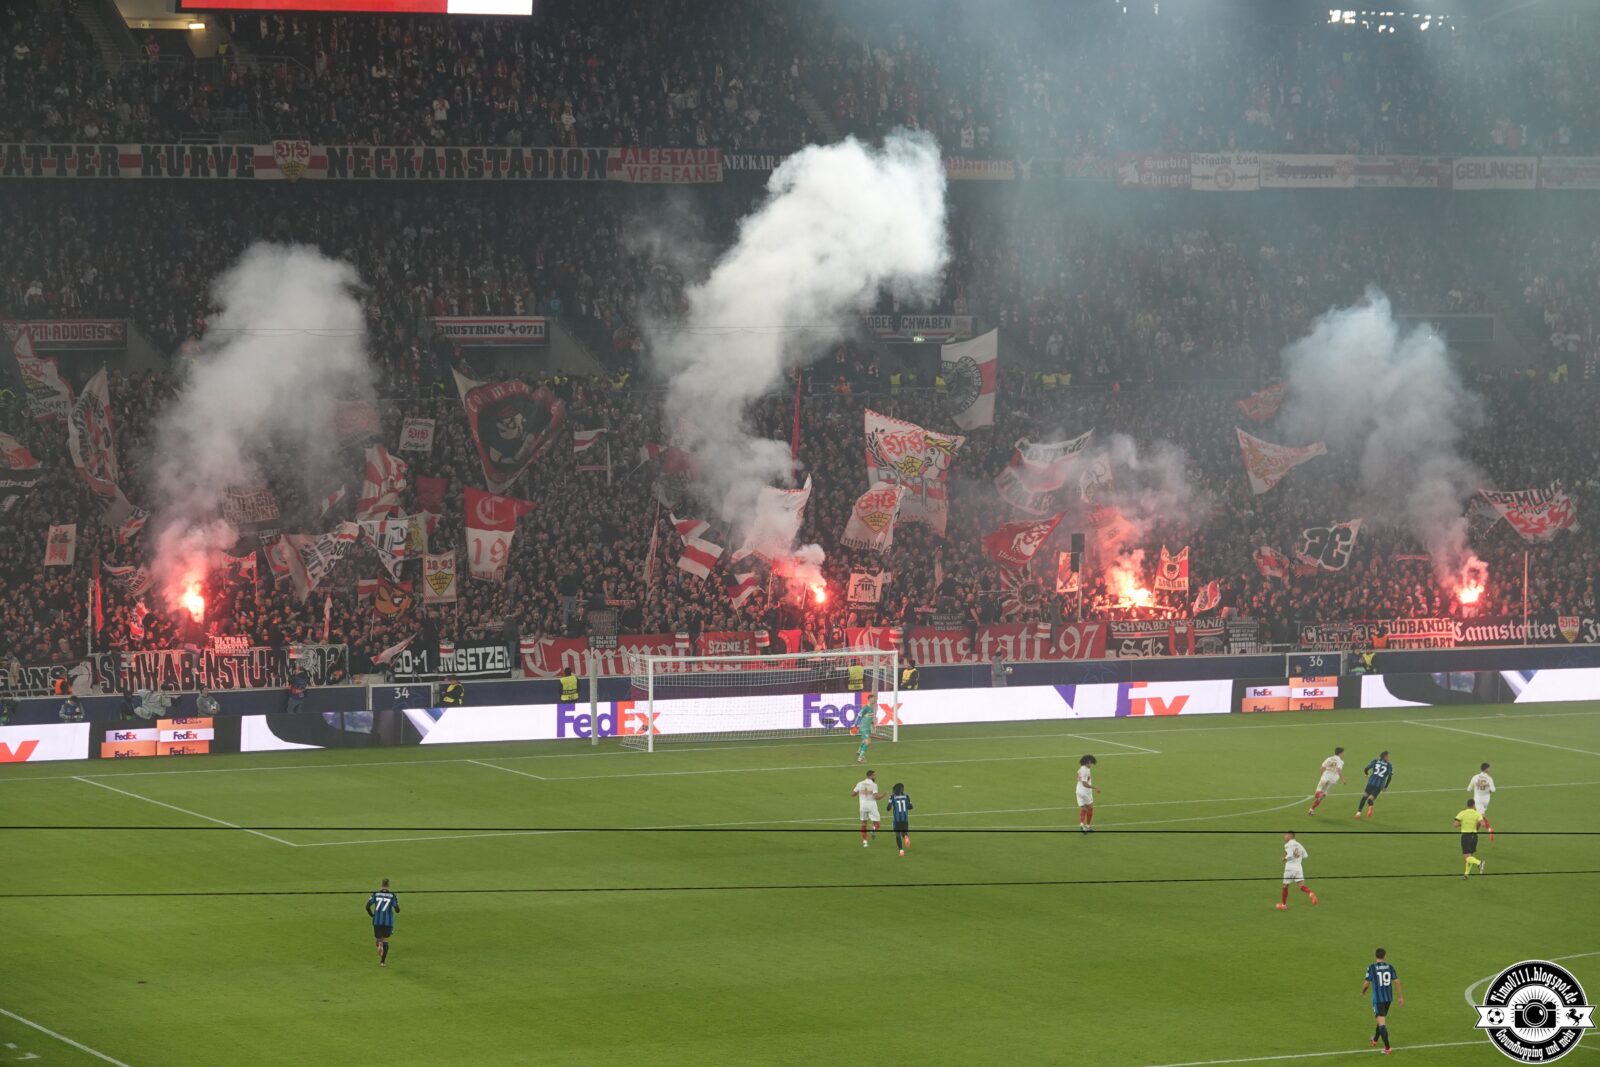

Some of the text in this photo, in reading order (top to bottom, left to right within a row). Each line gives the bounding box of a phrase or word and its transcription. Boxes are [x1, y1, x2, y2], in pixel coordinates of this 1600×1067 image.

[141, 145, 254, 177] KURVE
[326, 147, 609, 179] NECKARSTADION
[624, 149, 721, 164] ALBSTADT
[627, 166, 719, 182] VFB-FANS
[1454, 163, 1534, 180] GERLINGEN
[867, 317, 951, 329] OBERCHWABEN
[1058, 624, 1100, 661] 97
[1308, 655, 1324, 667] 36
[394, 687, 410, 699] 34
[1253, 688, 1273, 697] FedEx
[1303, 688, 1325, 697] FedEx
[557, 700, 661, 738] FedEx
[114, 731, 137, 741] FedEx
[173, 730, 198, 740] FedEx
[1373, 763, 1388, 778] 32
[896, 799, 907, 813] 11
[375, 896, 392, 912] 77
[1376, 971, 1392, 987] 19
